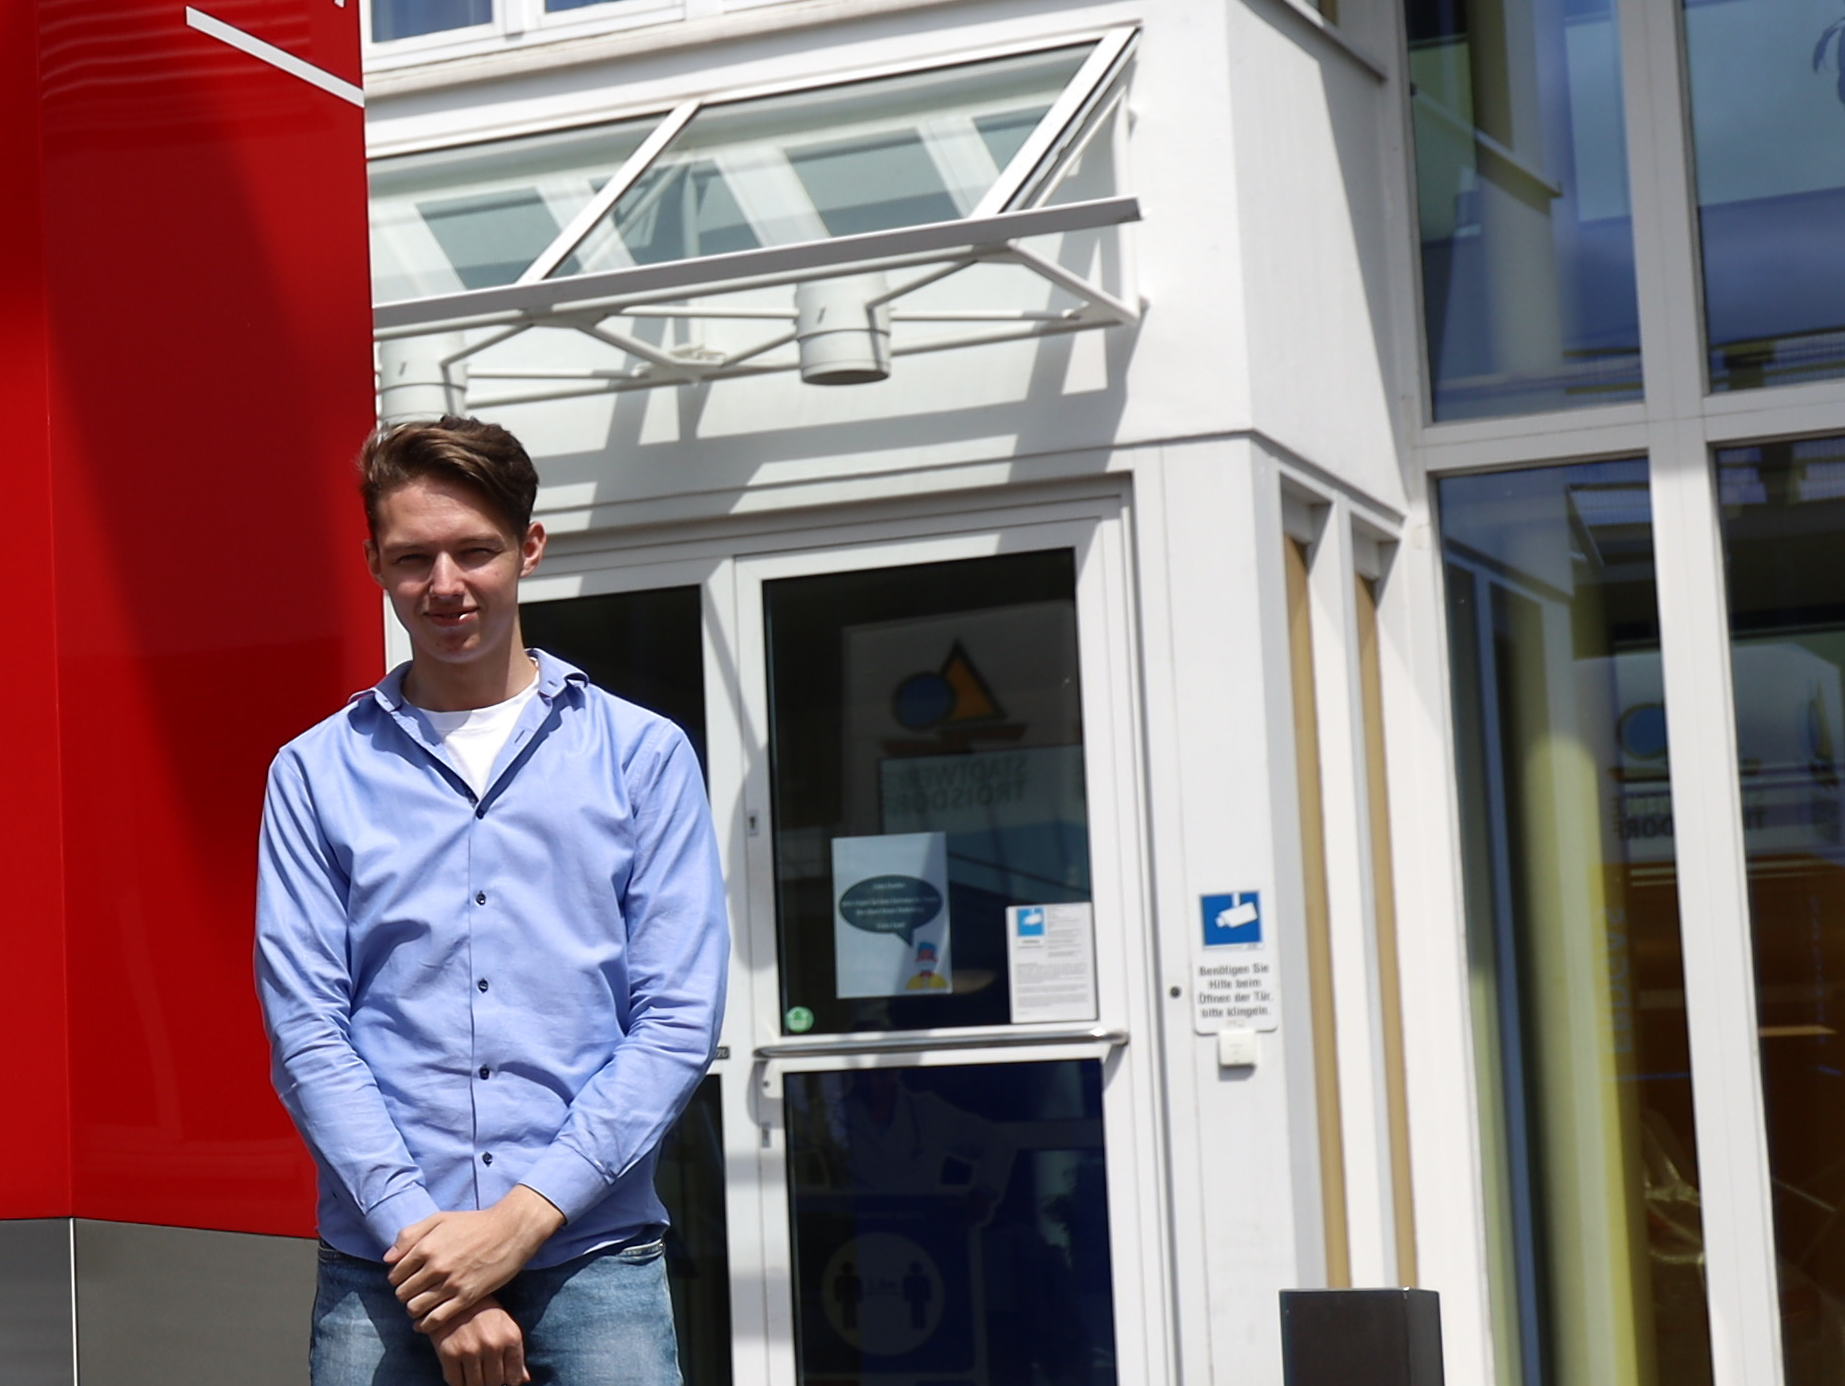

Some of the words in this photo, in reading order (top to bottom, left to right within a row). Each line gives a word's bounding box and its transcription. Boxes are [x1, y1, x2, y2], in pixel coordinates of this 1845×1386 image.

[1199, 965, 1250, 978] Benötigen
[1253, 963, 1270, 974] Sie
[1209, 979, 1232, 990] Hilfe
[1236, 979, 1261, 989] beim
[1235, 992, 1251, 1003] der
[1202, 1008, 1224, 1019] bitte
